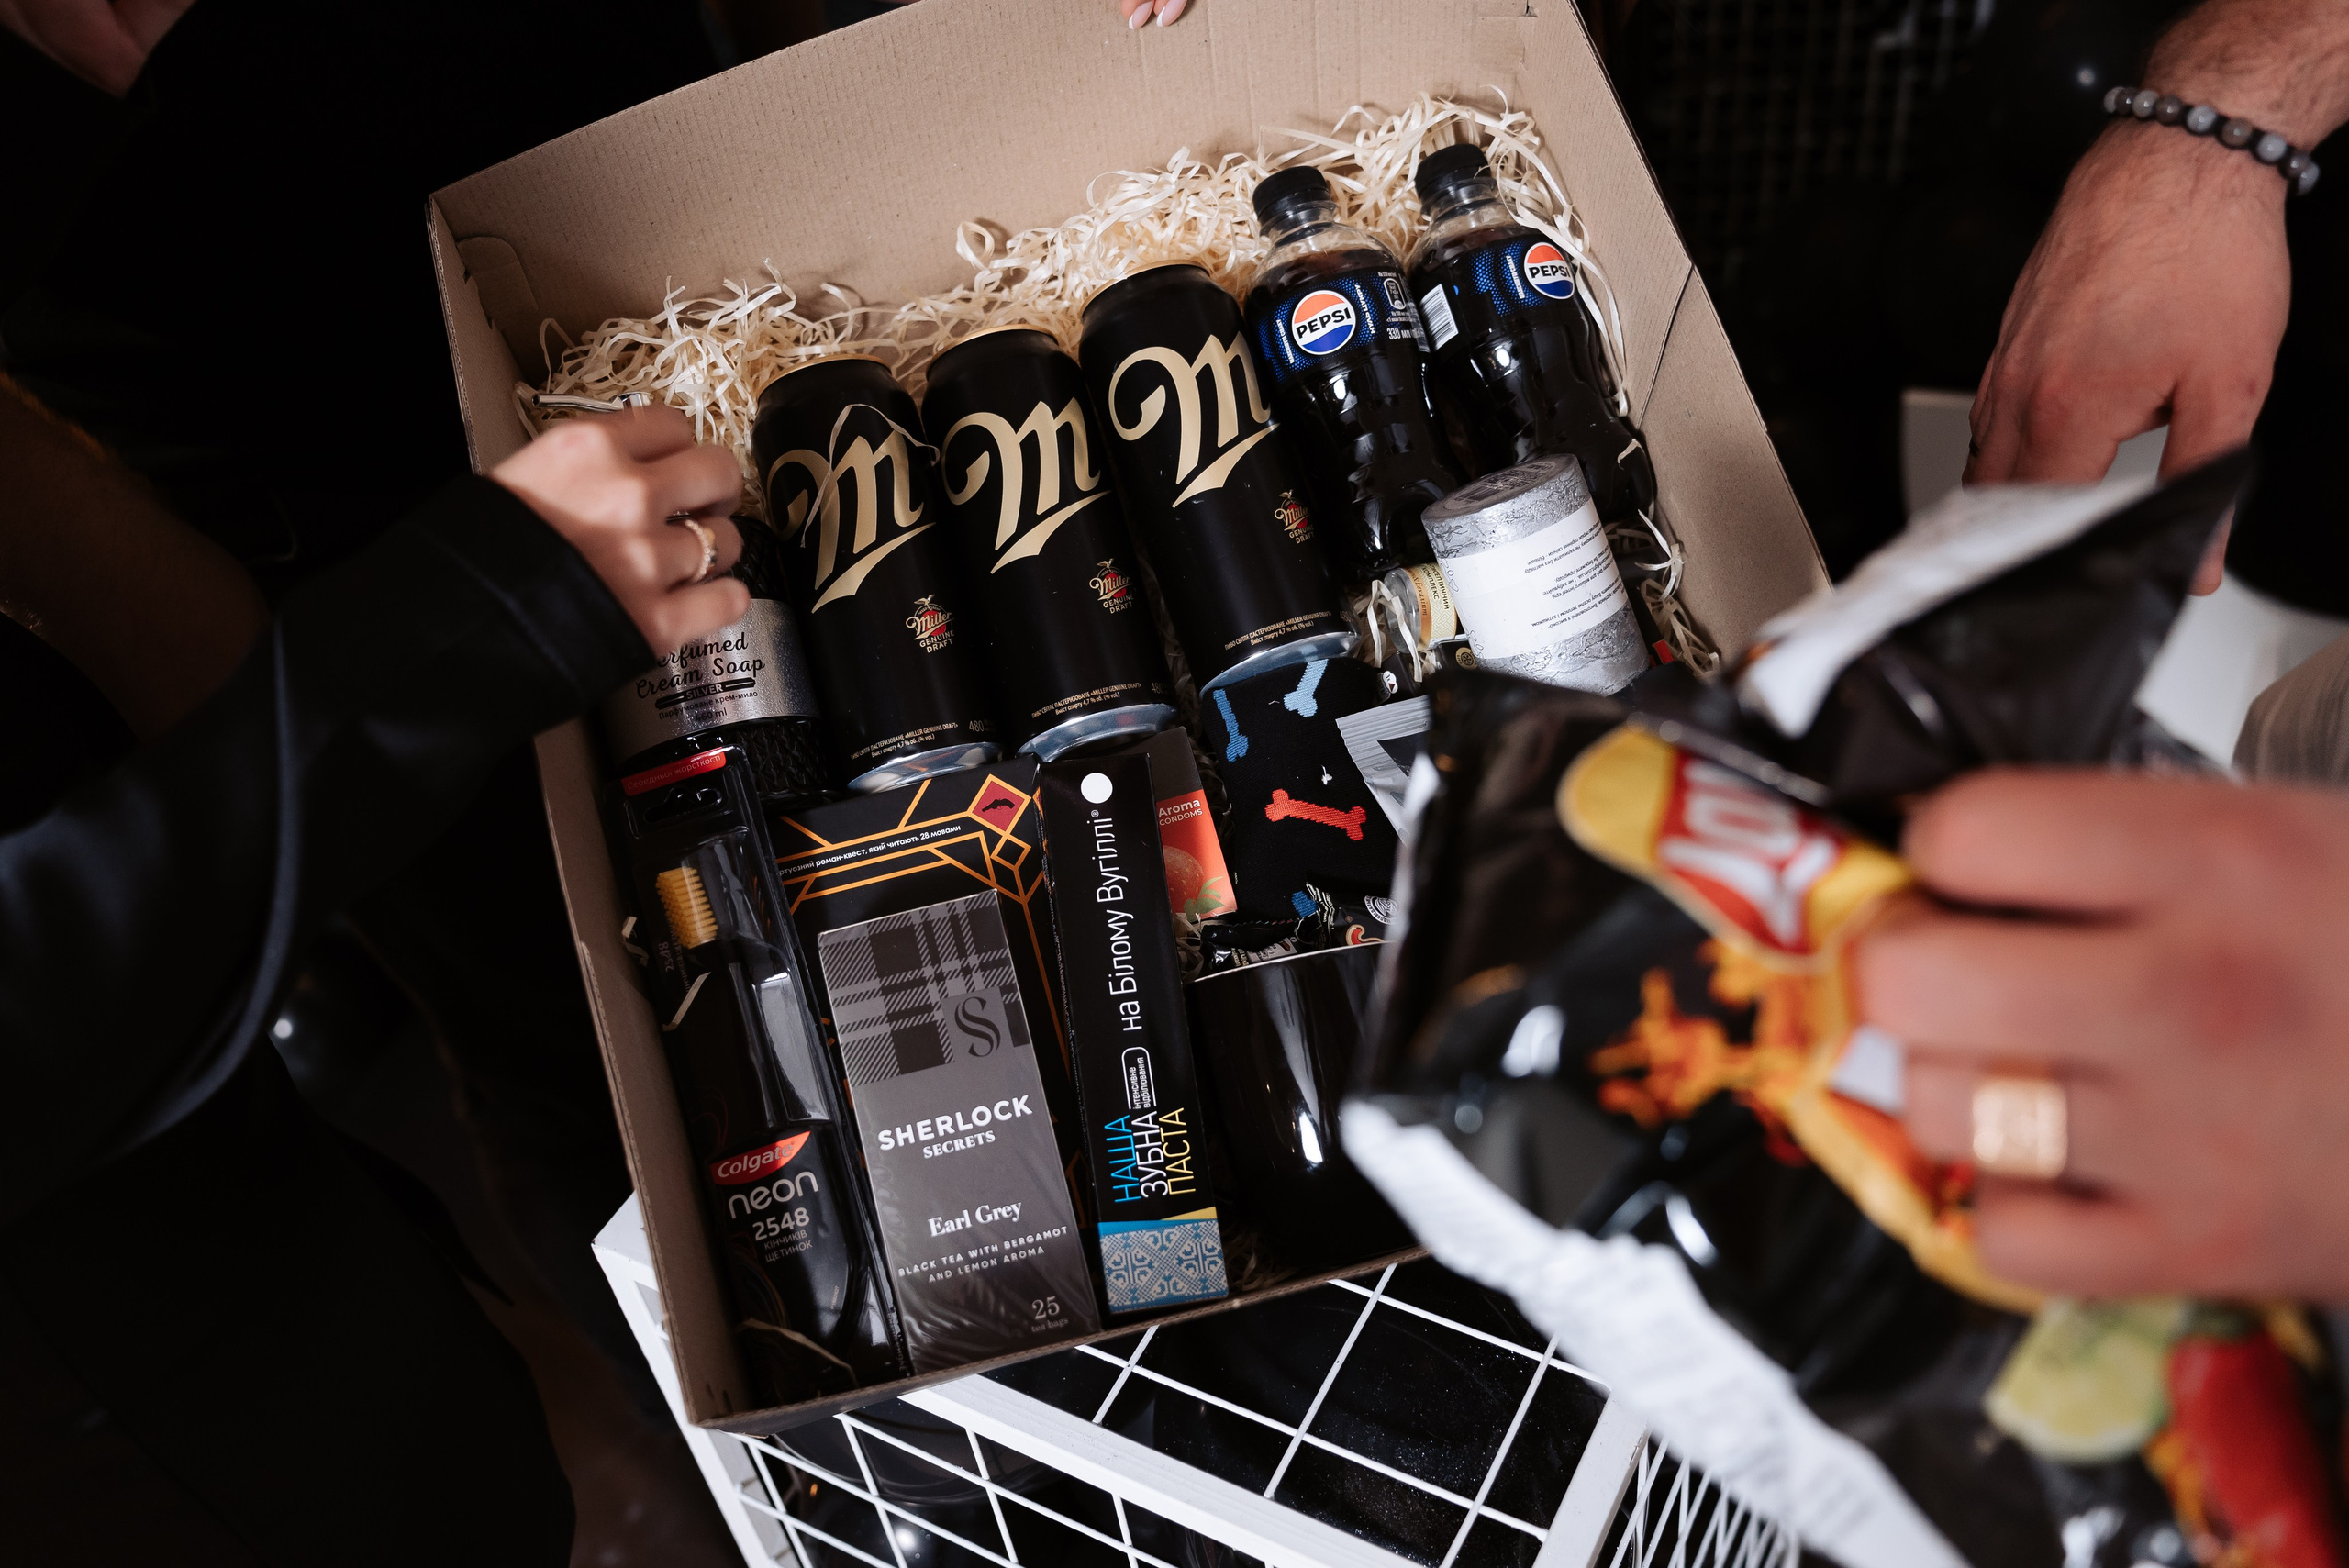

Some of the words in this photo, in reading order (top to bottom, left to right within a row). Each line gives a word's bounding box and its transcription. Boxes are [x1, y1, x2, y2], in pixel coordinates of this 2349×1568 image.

[1529, 265, 1571, 279] PEPSI
[1354, 284, 1369, 314] ЦУКРУ
[1297, 307, 1352, 339] PEPSI
[1365, 311, 1376, 334] НУЛЬ
[1386, 327, 1401, 340] 330
[1089, 575, 1131, 595] Miller
[1422, 566, 1440, 600] КОМПЛЕКС
[1103, 594, 1134, 608] GENUINE
[1109, 601, 1133, 614] DRAFT
[906, 612, 952, 635] Miller
[655, 631, 749, 669] erfumed
[919, 630, 955, 648] GENUINE
[926, 639, 953, 653] DRAFT
[636, 669, 704, 699] Cream
[712, 658, 765, 678] Soap
[686, 684, 724, 700] SILVER
[659, 698, 714, 720] Парфумоване
[715, 691, 759, 705] крем-мило
[715, 707, 728, 717] ml
[923, 725, 943, 734] GENUINE
[969, 720, 985, 732] 480
[627, 770, 674, 790] Середньої
[674, 755, 721, 775] жорсткості
[1158, 798, 1201, 818] Aroma
[1159, 808, 1203, 827] CONDOMS
[778, 861, 815, 876] ртуозний
[815, 849, 868, 868] роман-квест,
[868, 843, 886, 853] який
[886, 836, 919, 849] читають
[919, 832, 930, 840] 28
[930, 825, 962, 839] мовами
[658, 941, 674, 973] 2548
[1106, 908, 1138, 995] Білому
[1119, 1000, 1143, 1031] на
[1132, 1066, 1141, 1109] інтенсивне
[1138, 1056, 1151, 1108] відбілювання
[877, 1095, 1033, 1151] SHERLOCK
[922, 1129, 996, 1159] SECRETS
[1104, 1114, 1142, 1203] НАША
[1131, 1110, 1169, 1198] ЗУБНА
[1159, 1107, 1196, 1195] ПАСТА
[718, 1145, 794, 1178] Colgate
[728, 1171, 819, 1219] neon
[752, 1207, 810, 1241] 2548
[927, 1209, 973, 1237] Earl
[974, 1202, 1022, 1226] Grey
[763, 1229, 807, 1251] КІНЧИКІВ
[765, 1240, 813, 1262] ЩЕТИНОК
[897, 1260, 937, 1277] BLACK
[941, 1252, 963, 1267] TEA
[968, 1243, 999, 1259] WITH
[1004, 1226, 1068, 1251] BERGAMOT
[929, 1270, 952, 1283] AND
[957, 1258, 997, 1275] LEMON
[1003, 1246, 1045, 1263] AROMA
[1031, 1296, 1061, 1320] 25
[1030, 1323, 1046, 1333] tea
[1047, 1316, 1069, 1331] bags
